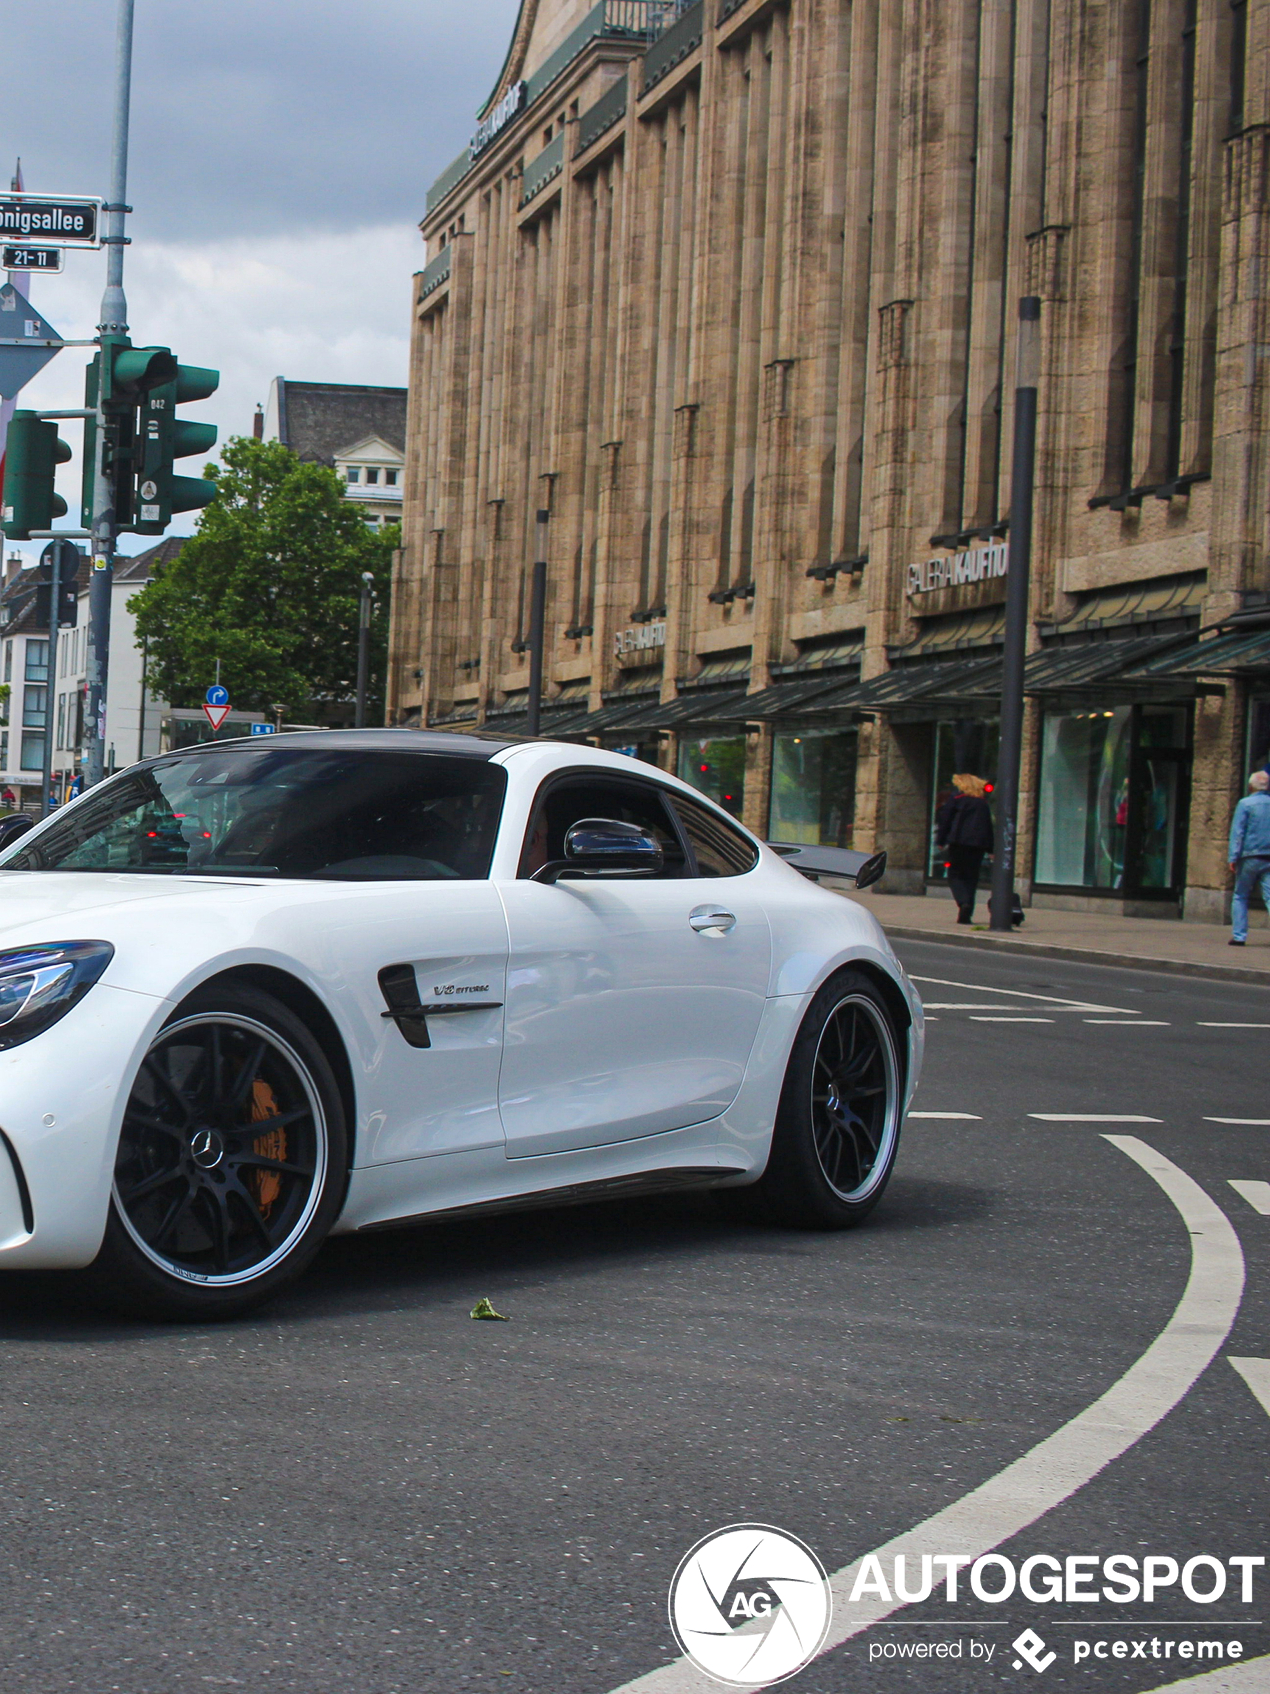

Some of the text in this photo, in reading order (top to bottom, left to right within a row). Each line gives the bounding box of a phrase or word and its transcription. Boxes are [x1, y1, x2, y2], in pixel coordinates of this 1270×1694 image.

[150, 399, 164, 409] 042
[906, 557, 956, 595] GALERIA
[434, 985, 455, 996] V8
